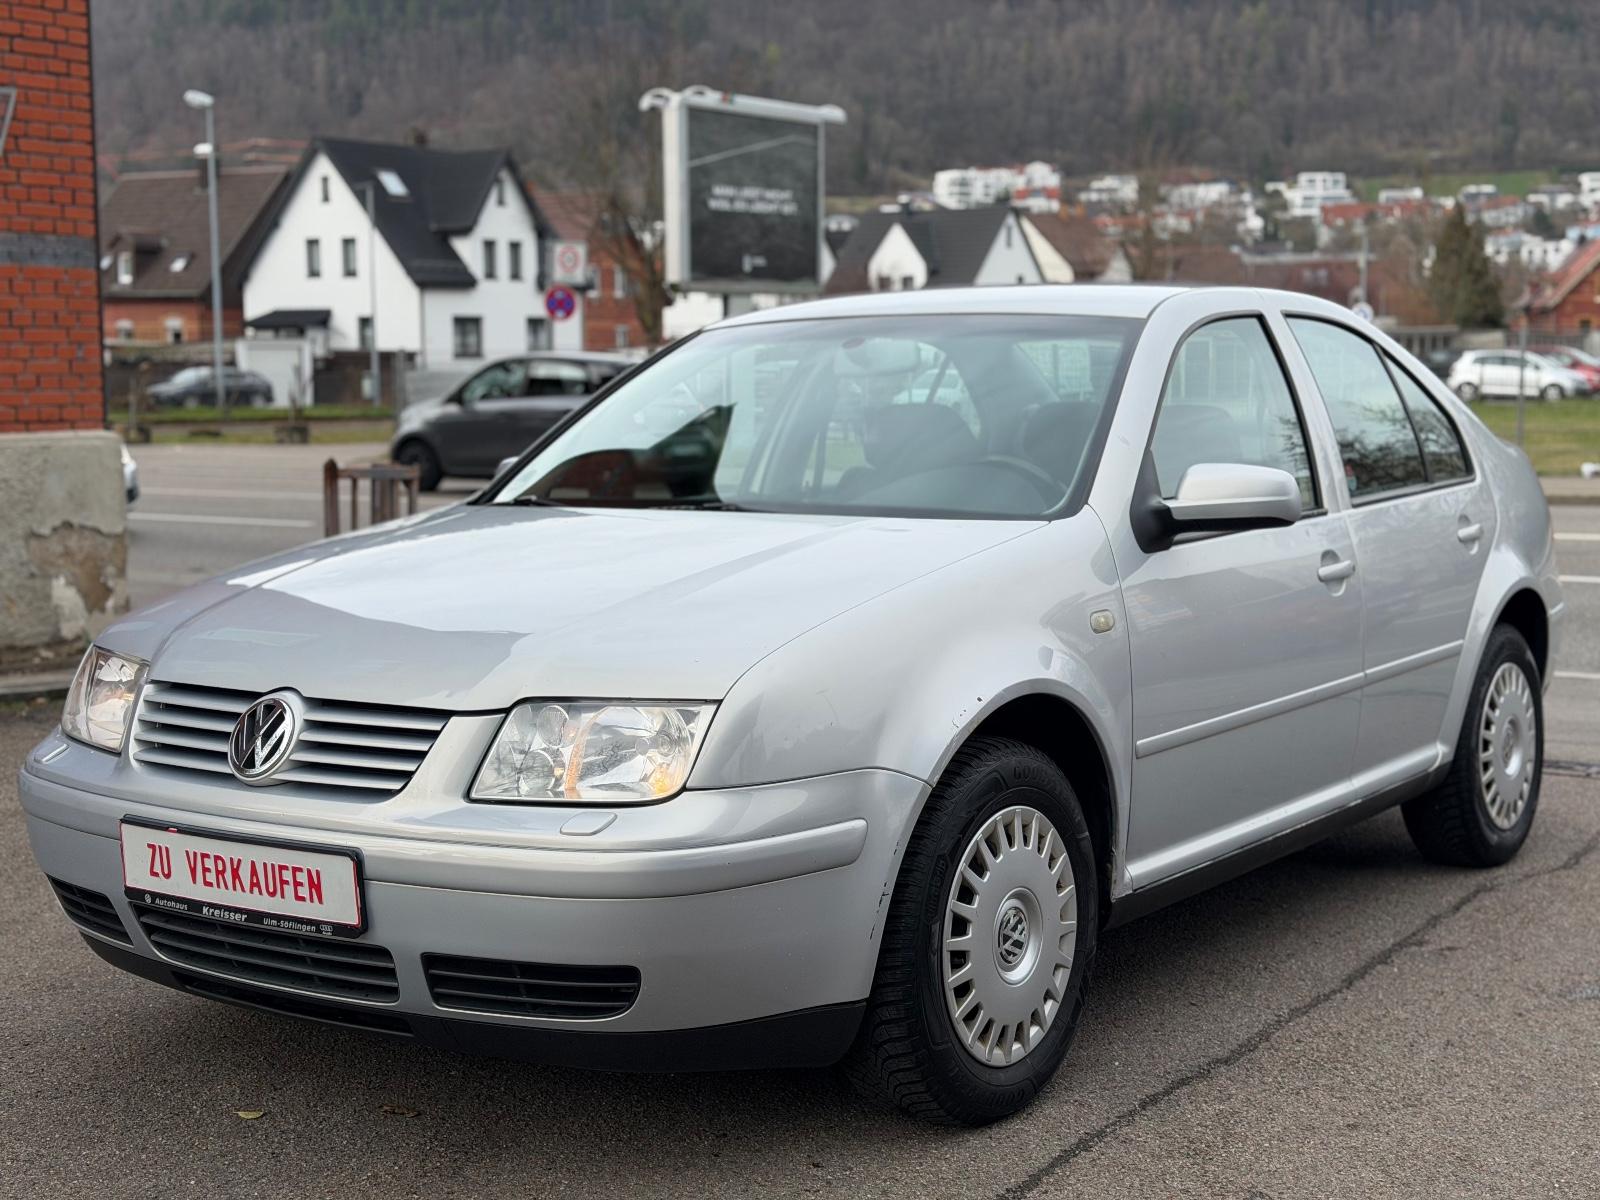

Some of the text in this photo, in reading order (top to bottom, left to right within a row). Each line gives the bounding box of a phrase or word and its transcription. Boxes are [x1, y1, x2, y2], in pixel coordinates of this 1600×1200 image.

[229, 698, 295, 780] VW
[147, 843, 324, 905] ZU VERKAUFEN
[155, 897, 188, 911] Autohaus
[202, 906, 248, 922] Kreisser
[263, 917, 316, 933] Ulm-Söflingen
